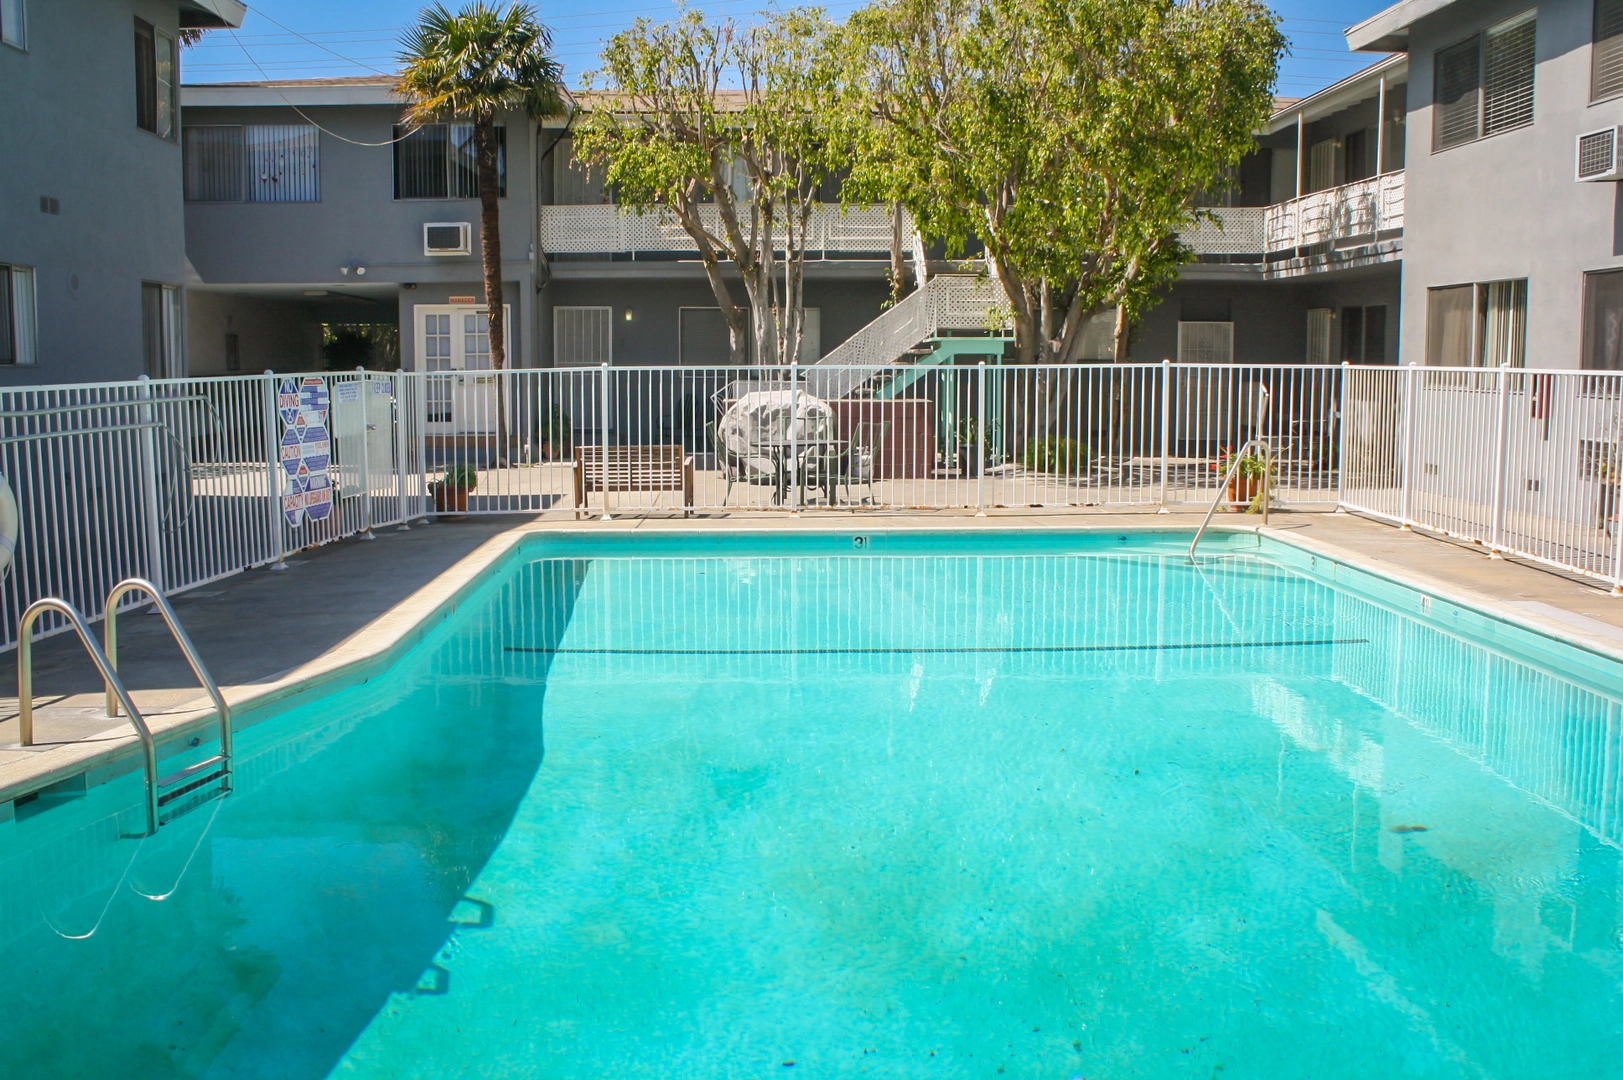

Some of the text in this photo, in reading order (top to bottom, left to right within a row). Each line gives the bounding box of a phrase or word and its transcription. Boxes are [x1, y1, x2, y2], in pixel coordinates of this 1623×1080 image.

[284, 379, 294, 393] NO
[280, 394, 299, 408] DIVING
[281, 445, 301, 460] CAUTION
[284, 494, 304, 510] CAPACITY
